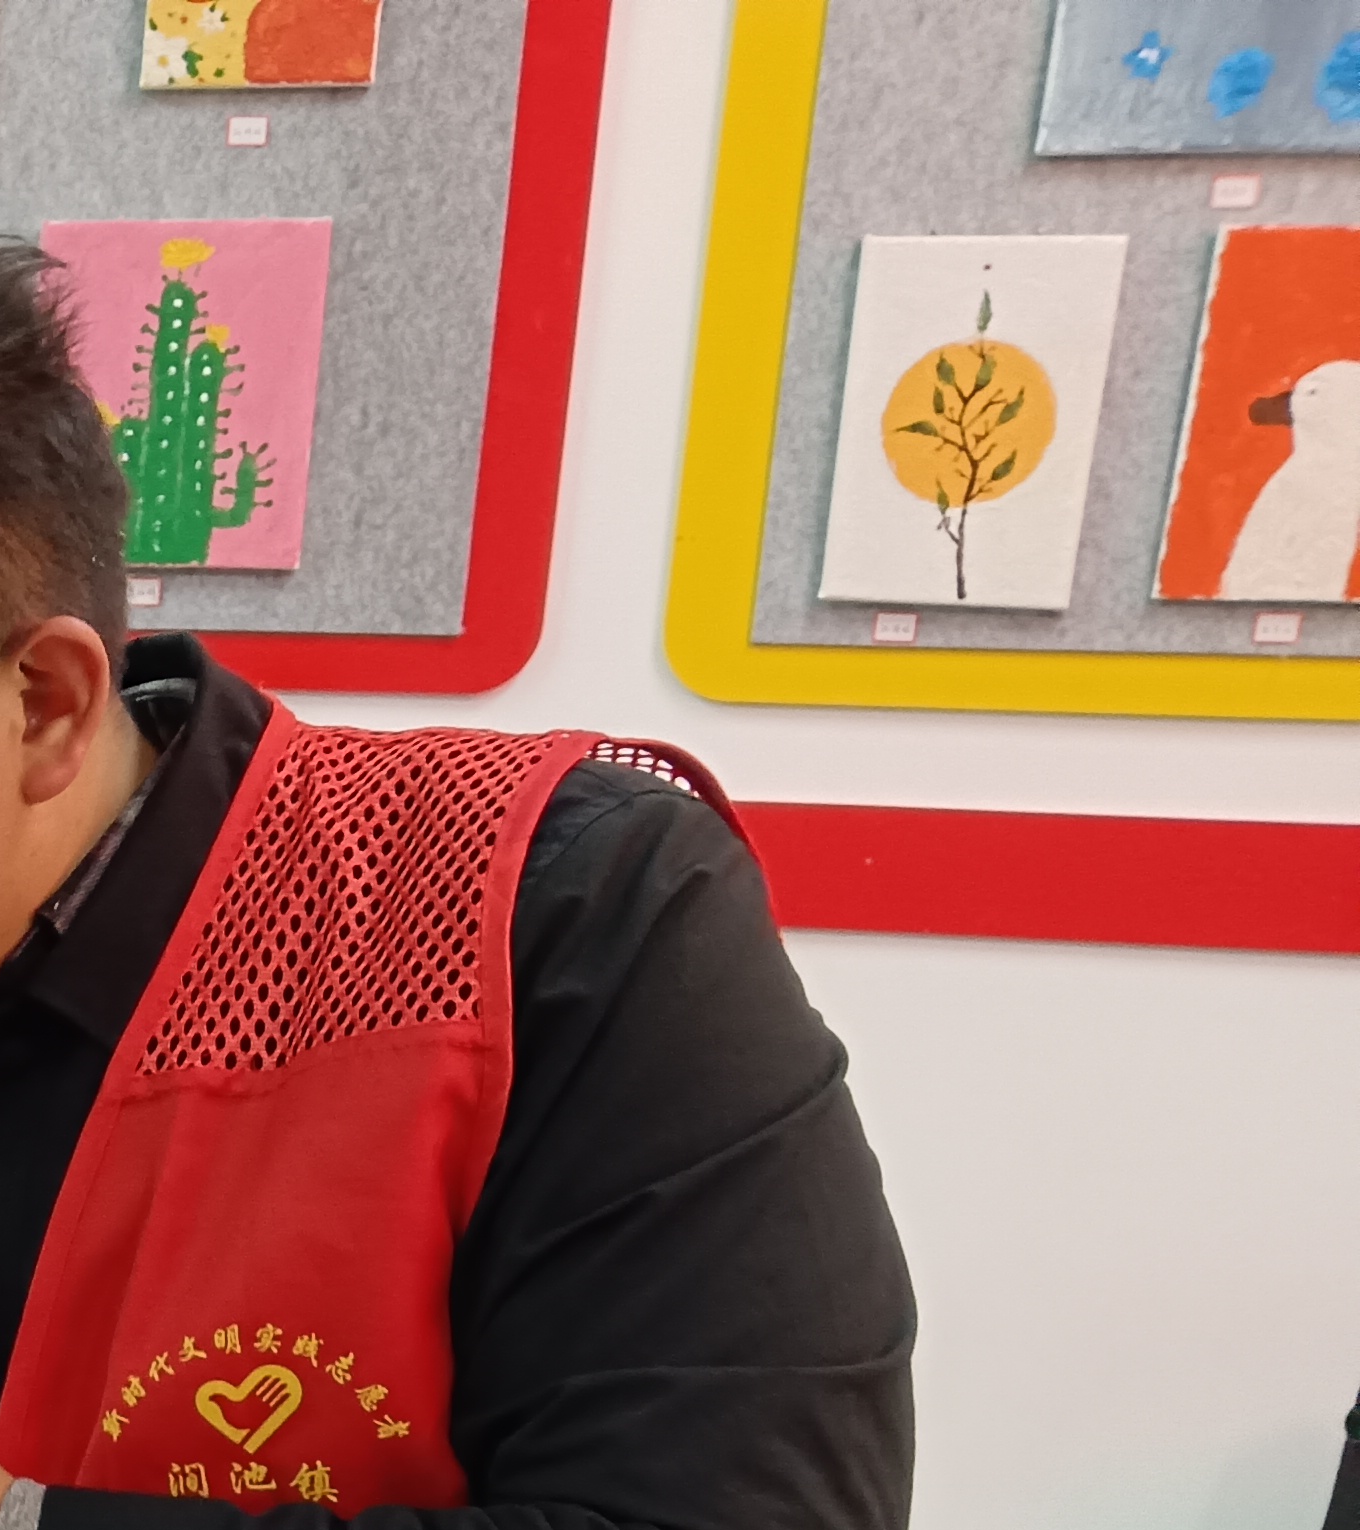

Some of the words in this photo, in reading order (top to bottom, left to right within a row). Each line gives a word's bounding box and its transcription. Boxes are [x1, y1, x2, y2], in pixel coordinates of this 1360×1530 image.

[101, 1322, 411, 1443] 新时代文明实践志愿者
[168, 1459, 339, 1503] 涧池镇
